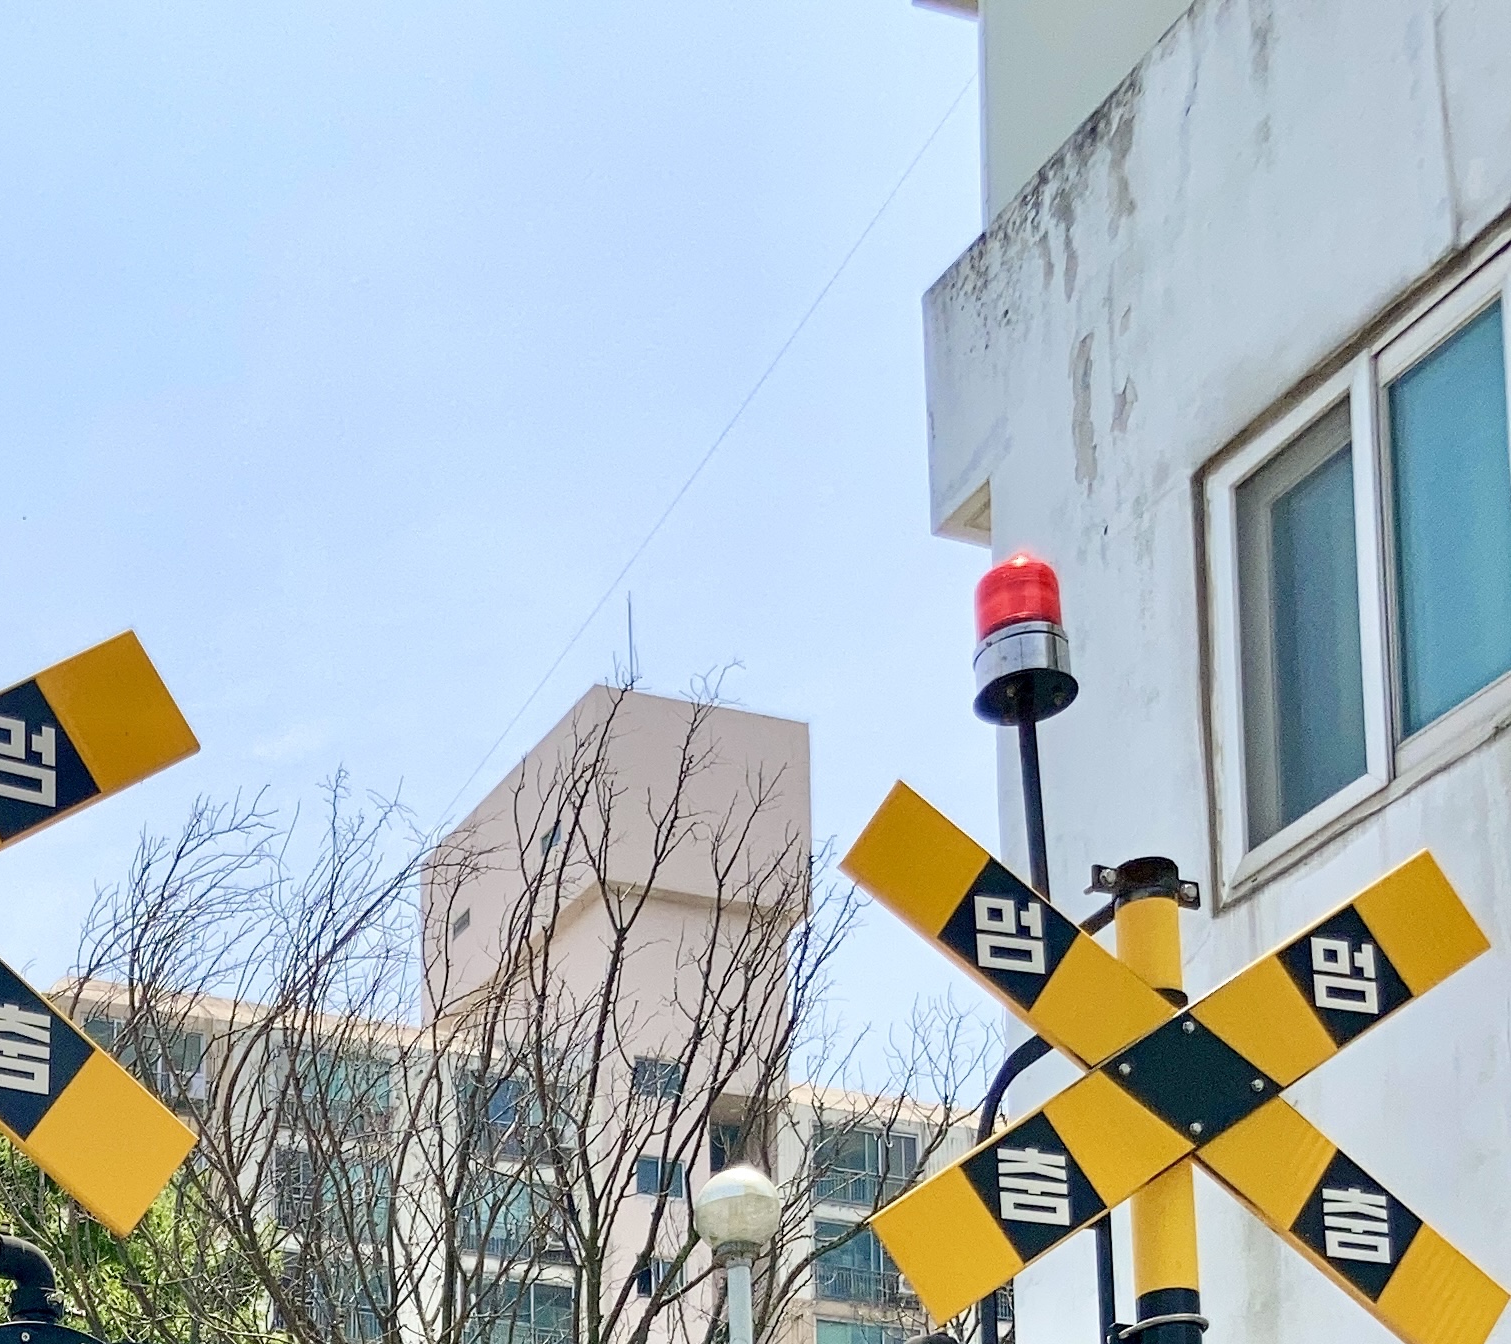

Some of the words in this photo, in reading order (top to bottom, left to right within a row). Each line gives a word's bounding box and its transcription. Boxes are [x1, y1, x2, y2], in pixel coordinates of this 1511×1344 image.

[974, 895, 1046, 975] 멈
[1310, 936, 1379, 1015] 멈
[996, 1147, 1071, 1227] 춤
[1322, 1186, 1391, 1264] 춤
